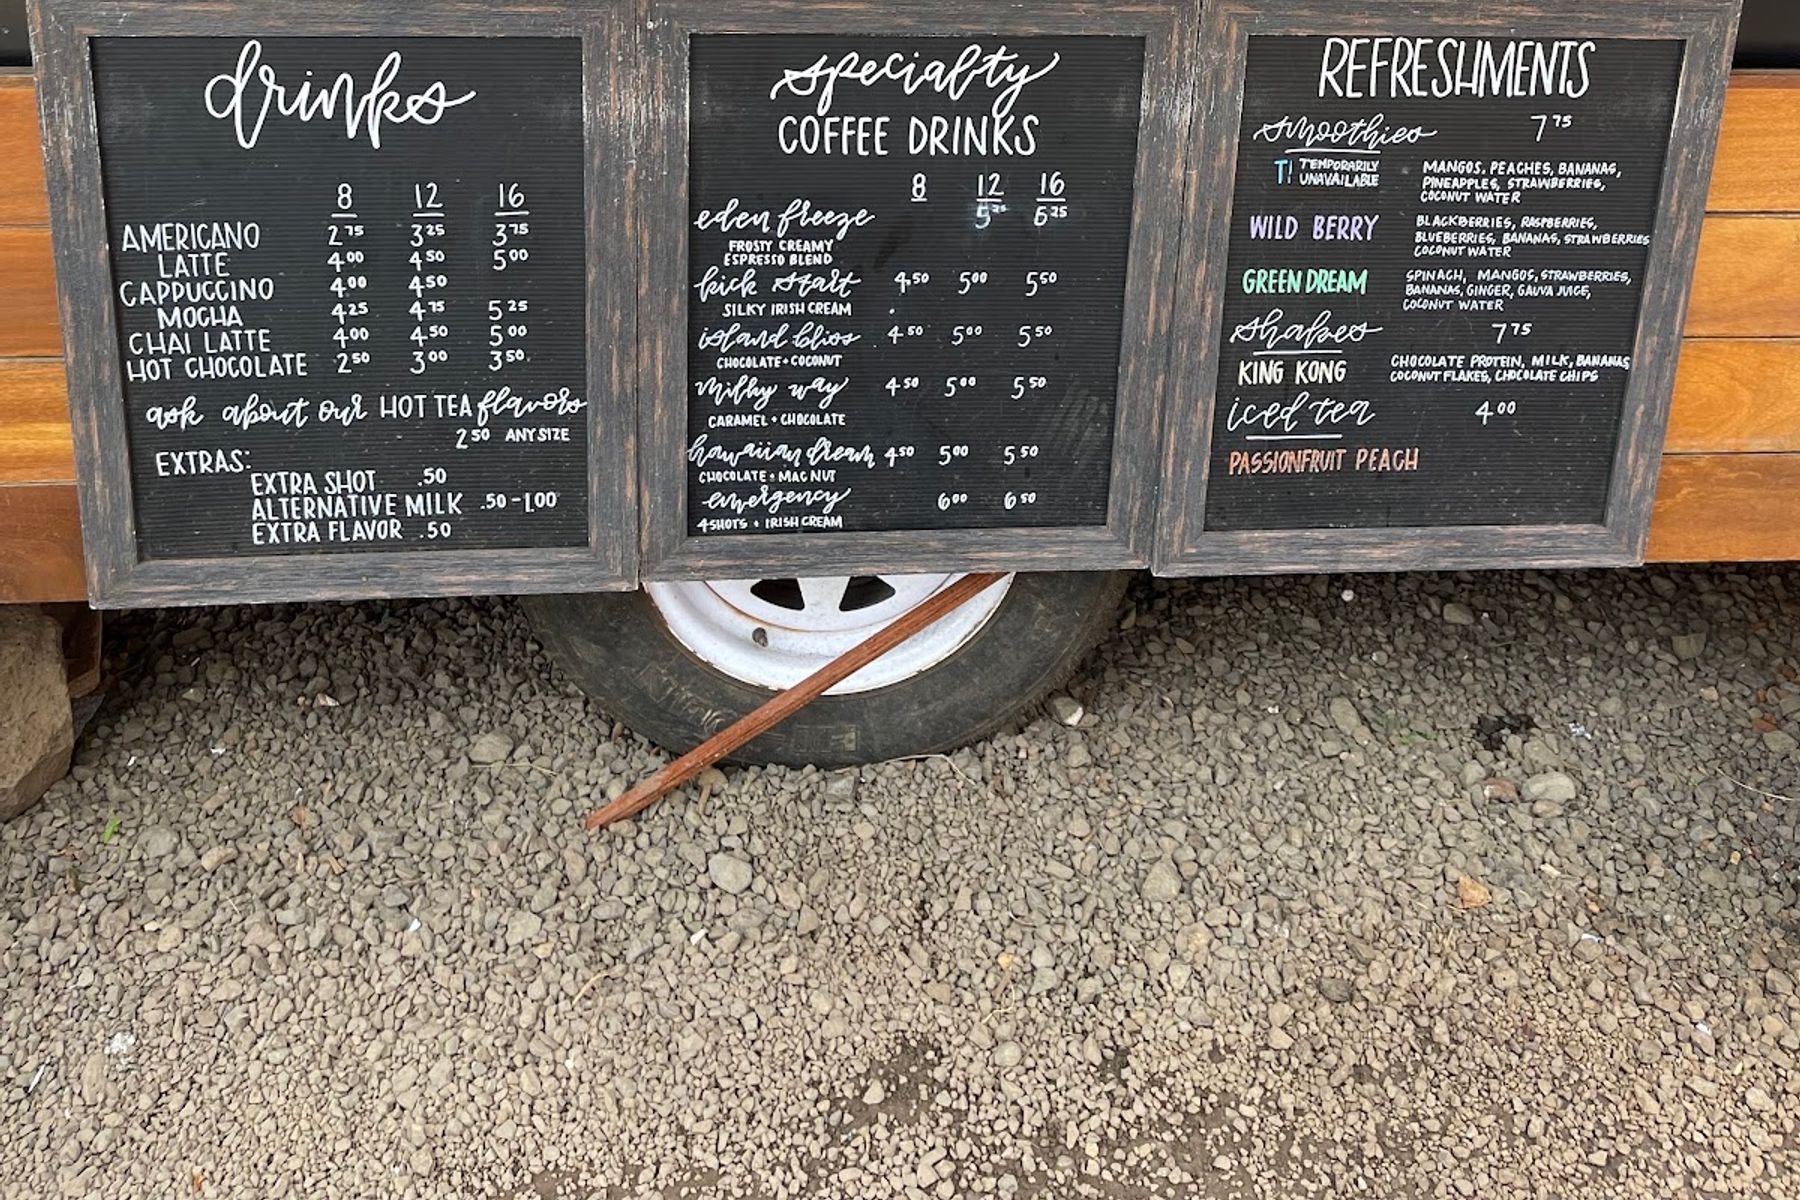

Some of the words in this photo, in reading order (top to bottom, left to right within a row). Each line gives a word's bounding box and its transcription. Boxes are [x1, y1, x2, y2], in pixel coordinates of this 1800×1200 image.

[1319, 37, 1595, 98] REFRESHMENTS
[770, 44, 1059, 119] specialty
[205, 40, 476, 149] drinks
[779, 116, 890, 155] COFFEE
[909, 113, 1038, 155] DRINKS
[1253, 113, 1437, 149] smoothies
[1299, 158, 1379, 171] TEMPORARILY
[1300, 172, 1379, 187] UNAVAILABLE
[338, 184, 352, 209] 8
[416, 183, 442, 208] 12
[500, 183, 524, 207] 16
[1421, 190, 1470, 202] COCONUT
[1475, 191, 1520, 204] WATER
[694, 201, 770, 233] eden
[777, 199, 875, 240] freeze
[1251, 215, 1298, 239] WILD
[1313, 215, 1379, 240] BERRY
[123, 222, 259, 252] AMERICANO
[729, 240, 773, 252] FROSTY
[779, 239, 833, 252] CREAMY
[1564, 234, 1649, 245] STRAWBERRIES
[724, 253, 785, 266] ESPRESSO
[790, 253, 832, 266] BLEND
[1414, 245, 1466, 257] COCONUT
[1468, 246, 1511, 257] WATER
[158, 252, 229, 278] LATTE
[120, 278, 273, 306] CAPPUCCINO
[694, 266, 757, 302] kick
[772, 269, 861, 297] start
[1243, 269, 1302, 293] GREEN
[1306, 269, 1367, 294] DREAM
[722, 304, 766, 317] SILKY
[771, 302, 804, 315] IRISH
[808, 302, 851, 315] CREAM
[1403, 298, 1454, 310] COCONUT
[1459, 299, 1503, 311] WATER
[157, 306, 243, 329] MOCHA
[1230, 309, 1383, 347] shakes
[129, 332, 191, 354] CHAI
[205, 329, 270, 353] LATTE
[699, 323, 789, 352] island
[792, 322, 861, 350] bliss
[127, 358, 172, 381] HOT
[185, 353, 307, 378] CHOCOLATE
[717, 356, 781, 369] CHOCOLATE
[791, 355, 842, 367] COCONUT
[1239, 360, 1283, 385] KING
[1295, 360, 1346, 384] KONG
[1391, 355, 1465, 368] CHOCOLATE
[1390, 370, 1442, 382] COCONUT
[1495, 370, 1557, 381] CHOCOLATE
[1560, 370, 1598, 381] CHIPS
[788, 377, 849, 409] way
[146, 396, 204, 430] ask
[223, 394, 309, 430] about
[319, 394, 367, 426] our
[380, 395, 426, 418] HOT
[434, 394, 472, 417] TEA
[478, 386, 588, 423] flavors
[709, 415, 768, 428] CARAMEL
[781, 413, 845, 425] CHOCOLATE
[1228, 392, 1309, 432] iced
[1309, 398, 1375, 425] tea
[156, 449, 251, 476] EXTRAS:
[687, 434, 801, 467] hawaiian
[806, 437, 875, 468] dream
[1229, 449, 1346, 475] PASSIONFRUIT
[1356, 448, 1418, 471] PEACH
[251, 472, 317, 495] EXTRA
[325, 470, 375, 494] SHOT
[699, 470, 766, 483] CHOCOLATE
[252, 494, 397, 520] ALTERNATIVE
[406, 493, 462, 516] MILK
[702, 485, 851, 514] emergency
[253, 521, 320, 544] EXTRA
[329, 519, 402, 541] FLAVOR
[766, 517, 798, 528] IRISH
[801, 515, 842, 528] CREAM
